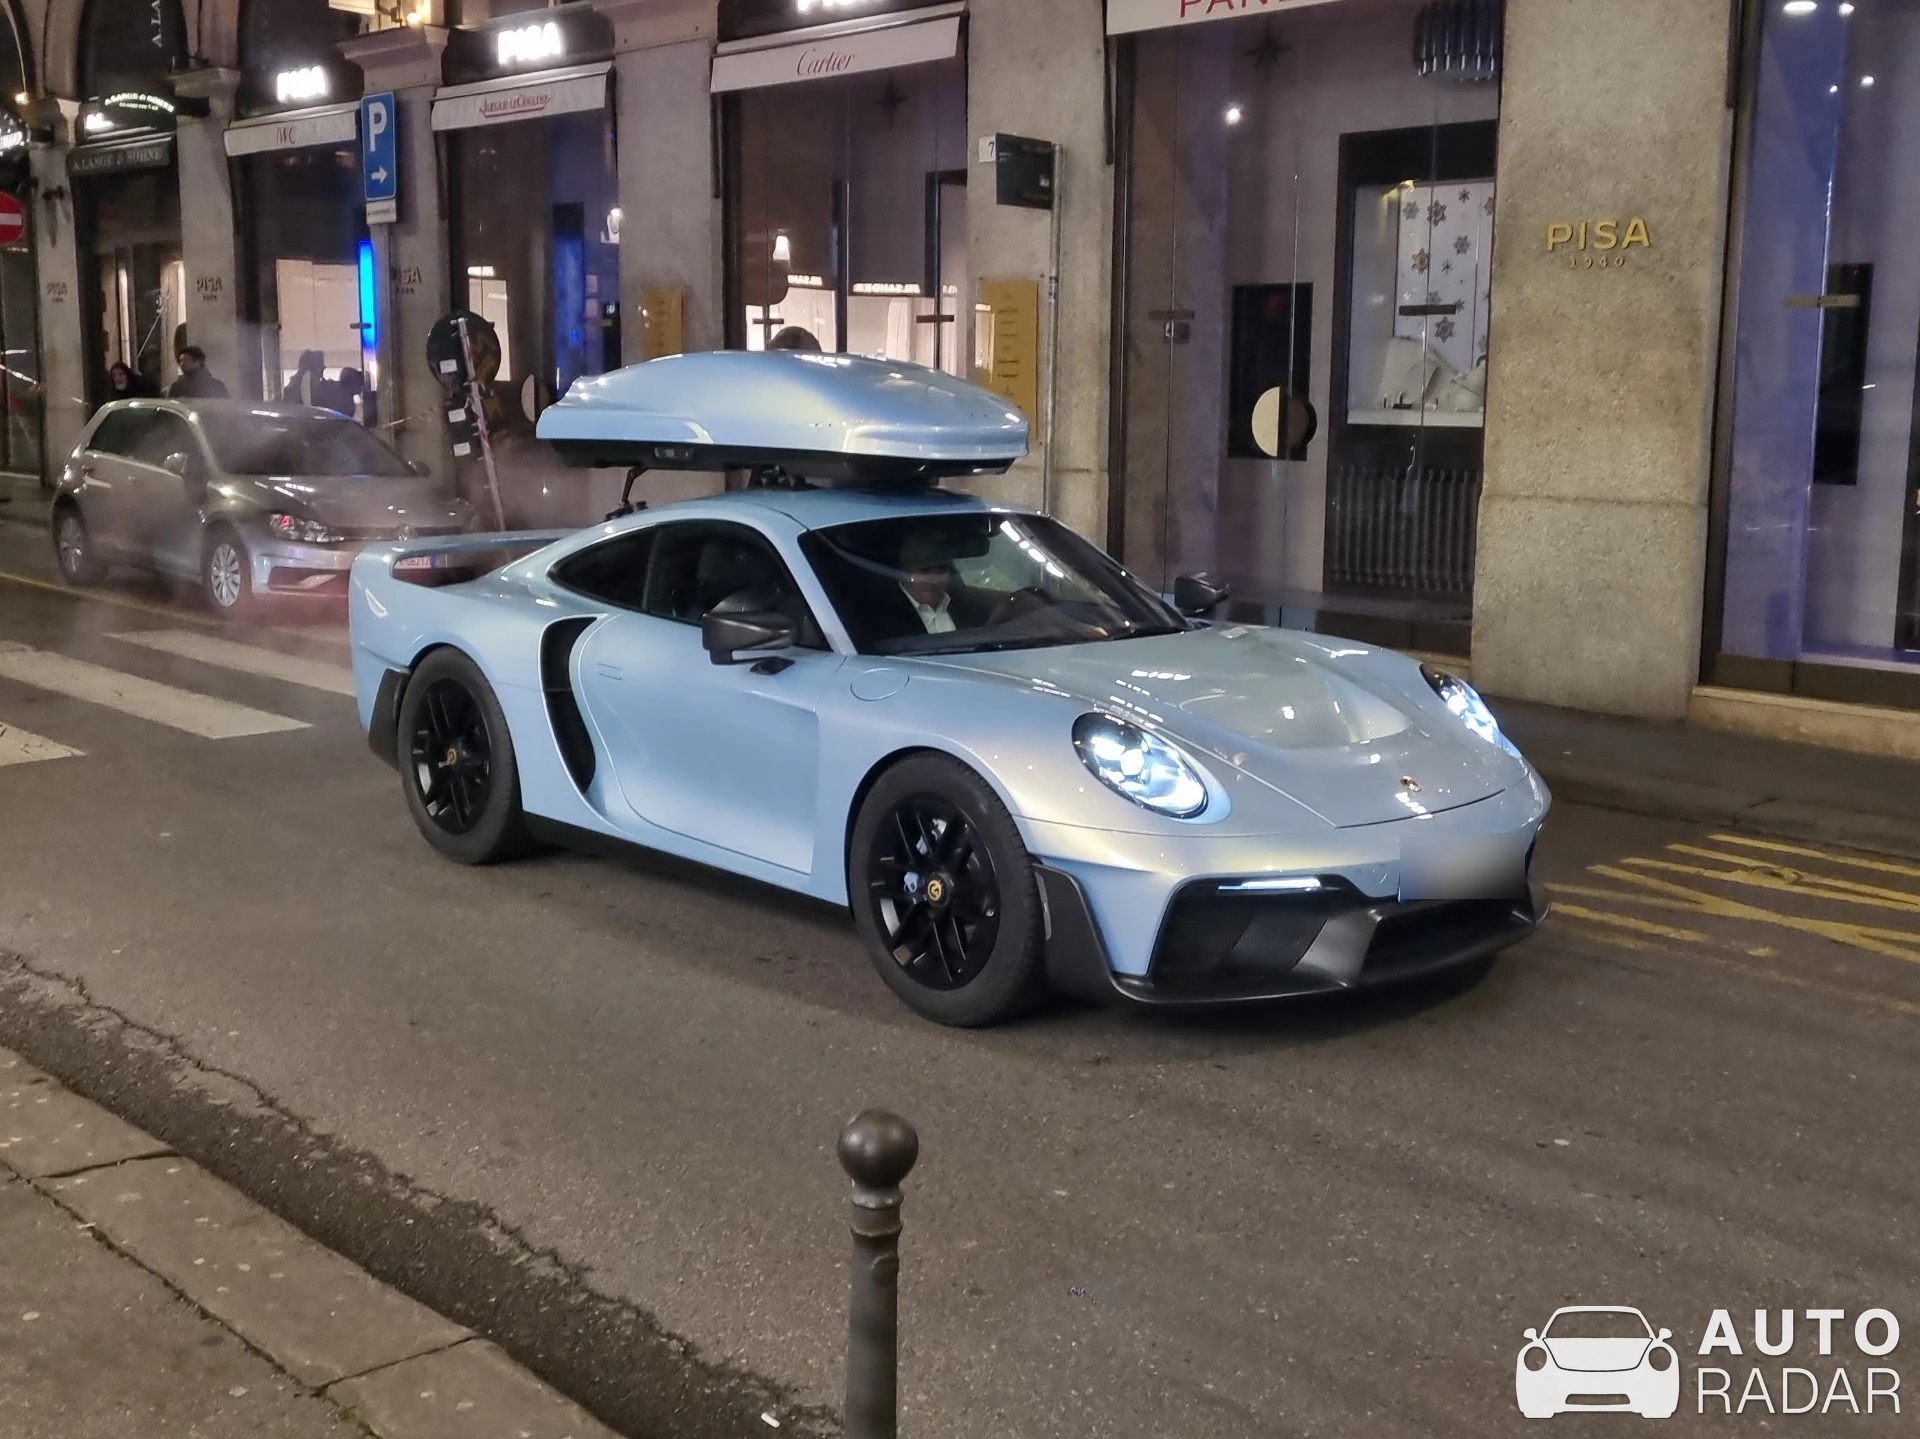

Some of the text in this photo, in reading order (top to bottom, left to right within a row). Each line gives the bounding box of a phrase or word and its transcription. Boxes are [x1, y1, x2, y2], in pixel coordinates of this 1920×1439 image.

[796, 48, 856, 75] Cartier
[368, 101, 388, 152] P
[1546, 217, 1652, 252] PISA
[1569, 254, 1625, 269] 1940
